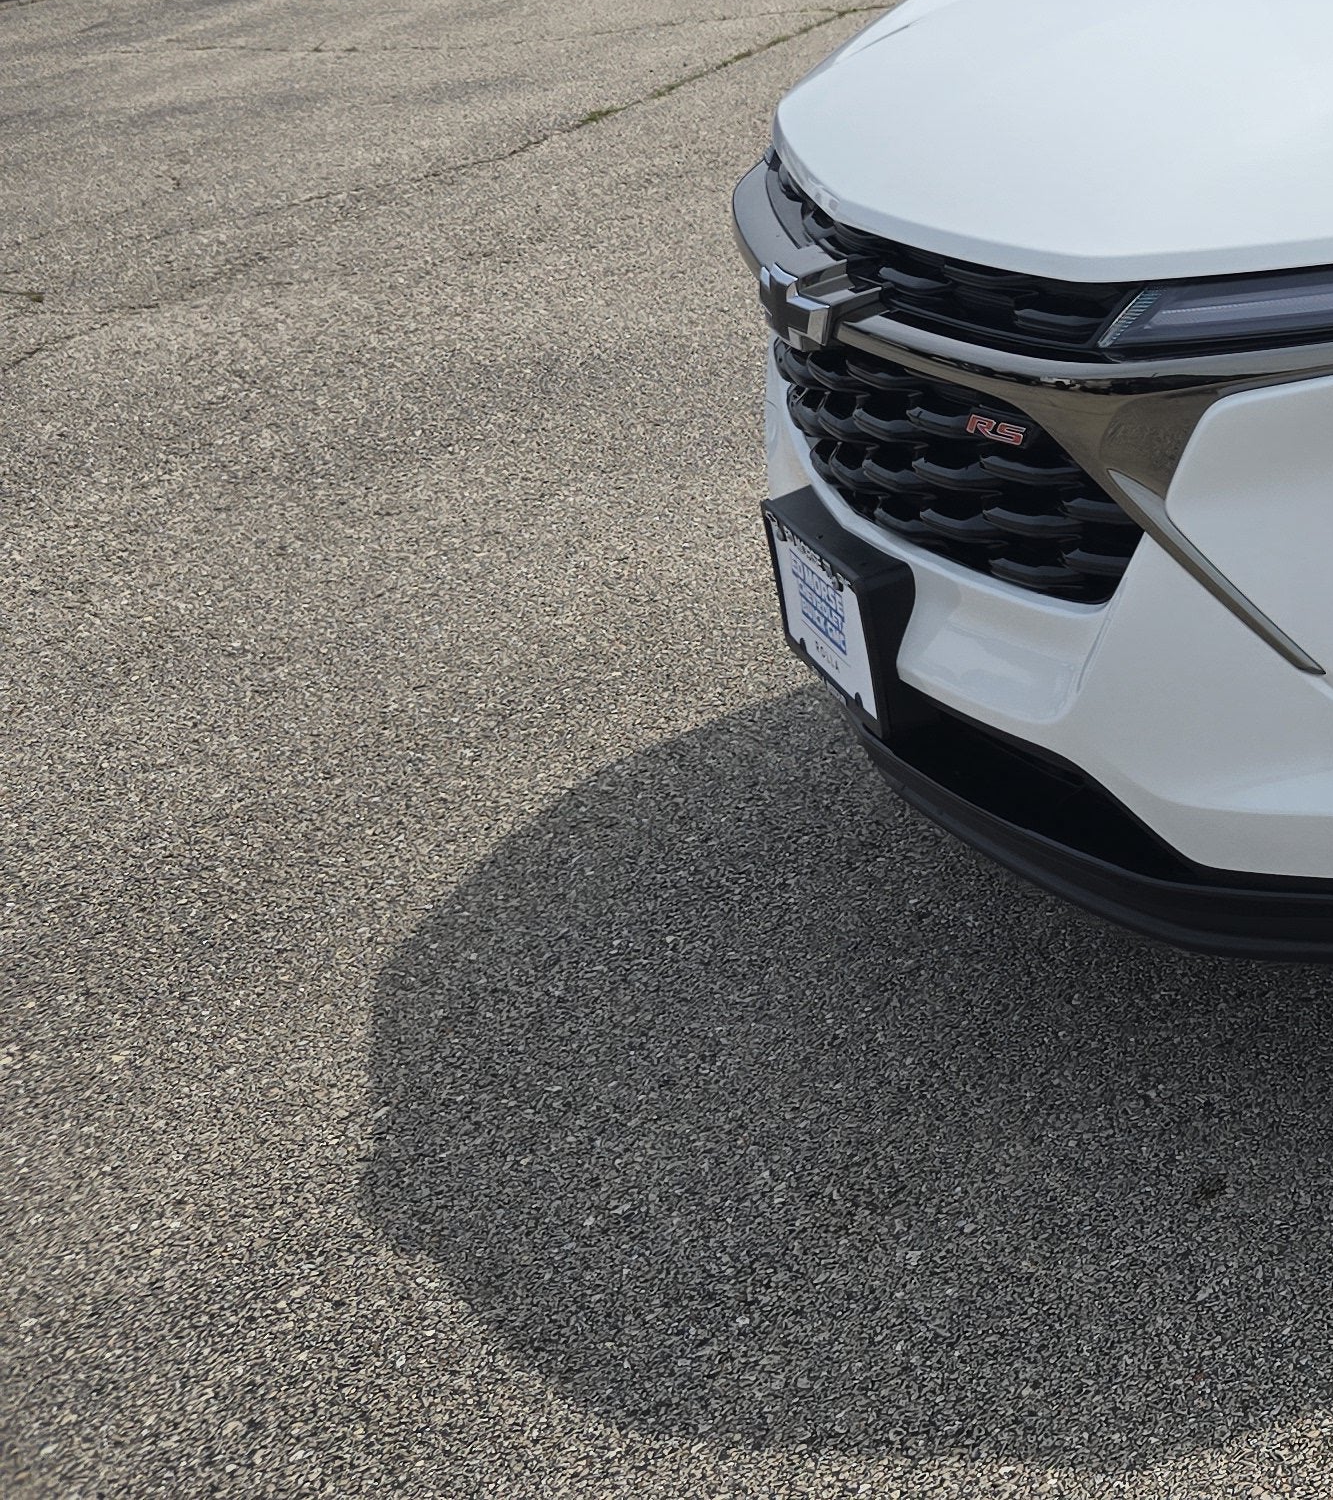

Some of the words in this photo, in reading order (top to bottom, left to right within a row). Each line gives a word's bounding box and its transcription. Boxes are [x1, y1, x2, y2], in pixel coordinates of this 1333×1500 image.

[966, 414, 1026, 446] RS
[788, 548, 806, 584] ED
[803, 560, 845, 621] MORSE
[814, 639, 840, 673] ROLLA
